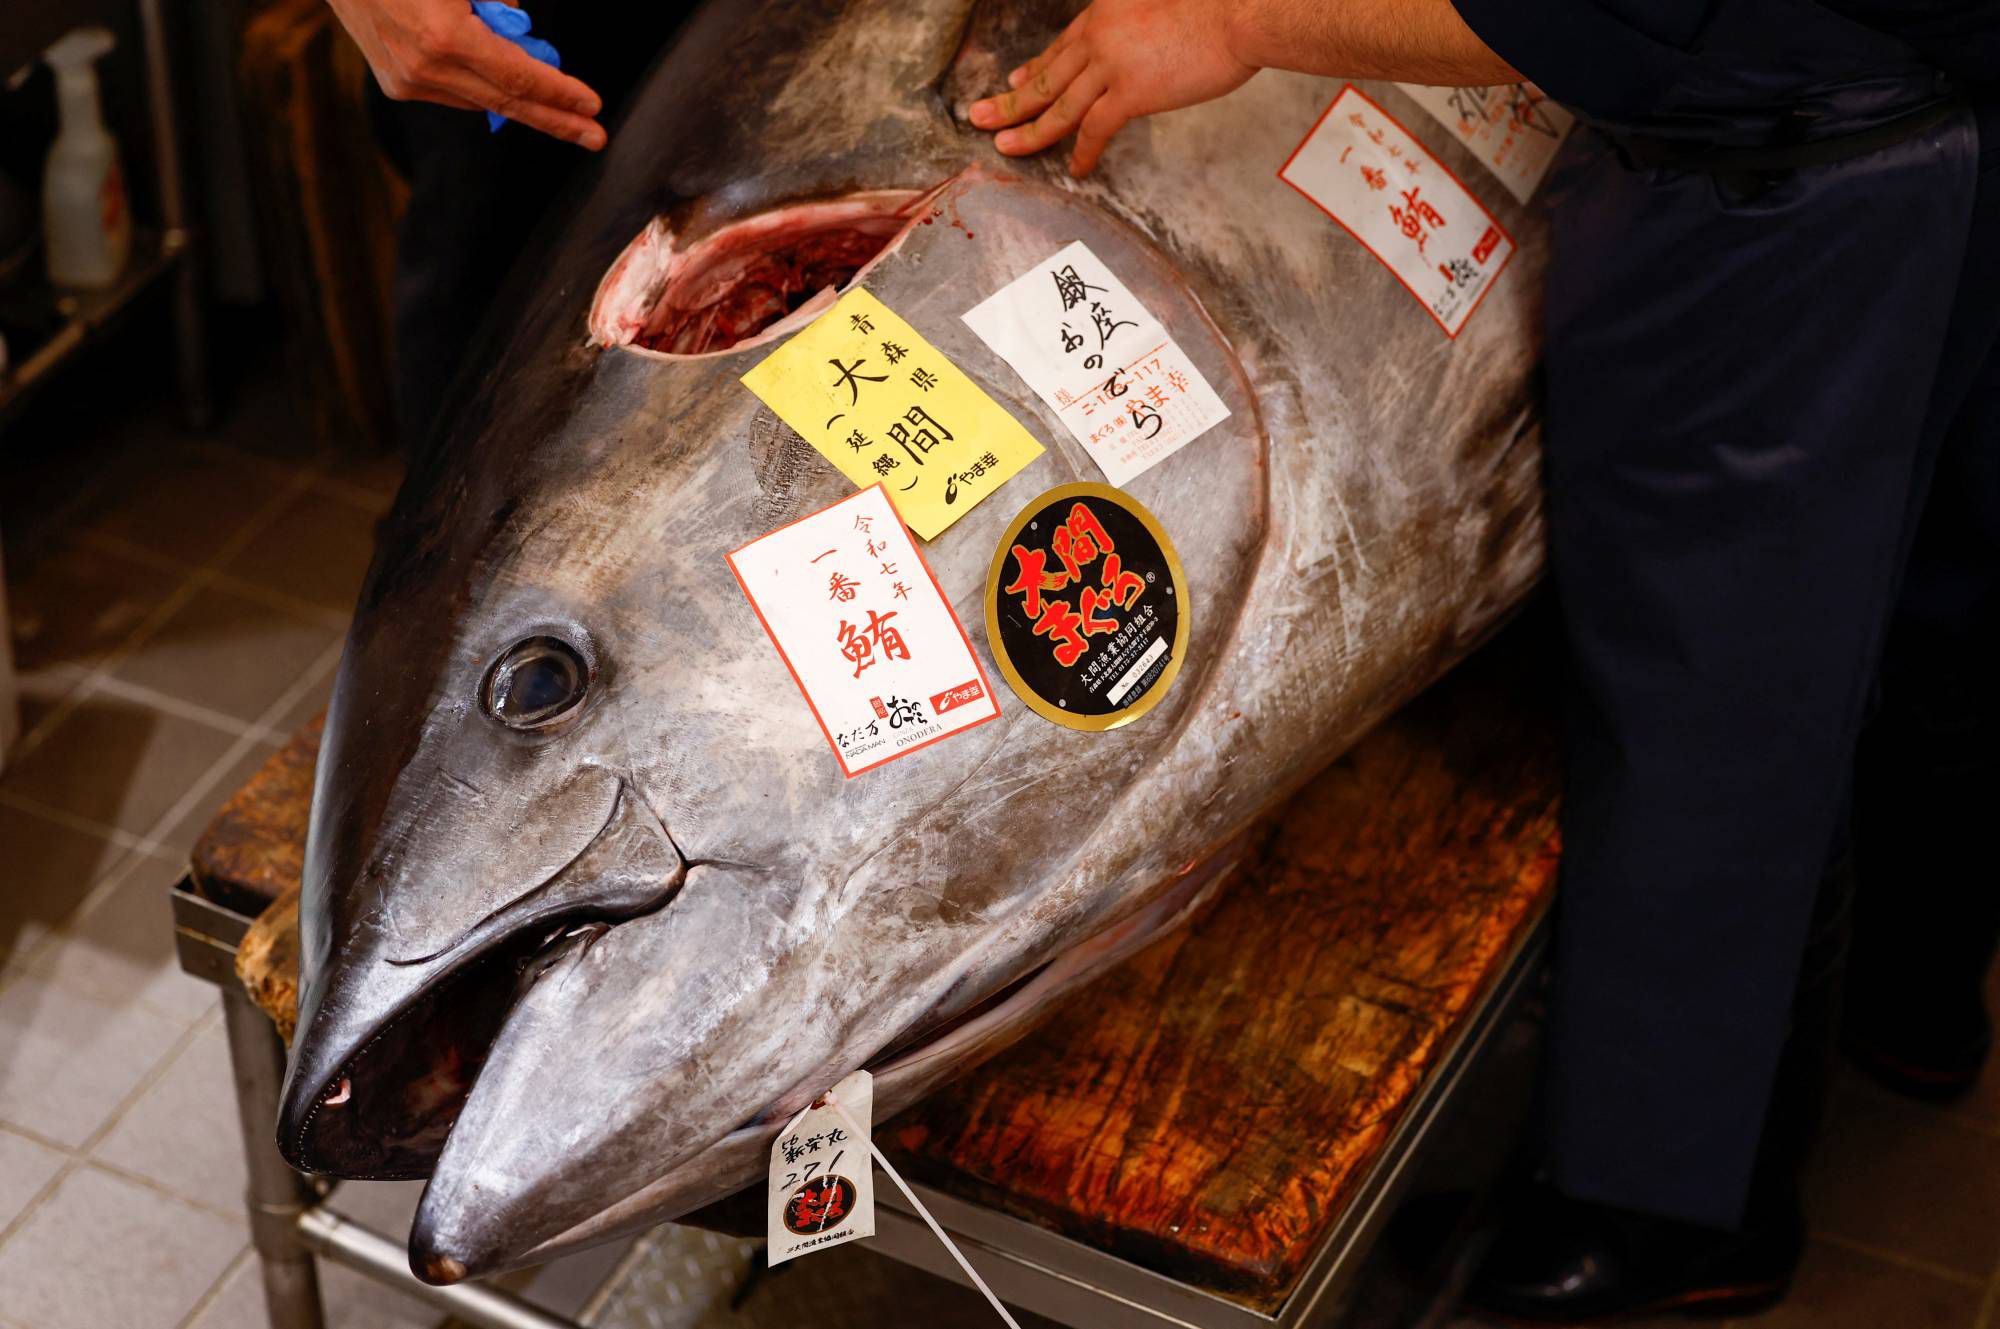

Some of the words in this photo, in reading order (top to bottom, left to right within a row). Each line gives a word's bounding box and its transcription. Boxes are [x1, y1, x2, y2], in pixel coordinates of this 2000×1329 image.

[850, 313, 938, 392] 青森県
[1061, 322, 1162, 440] おのでら
[828, 358, 954, 466] 大間
[959, 451, 999, 486] やま幸
[854, 514, 912, 600] 令和七年
[1005, 502, 1115, 619] 大間
[1033, 553, 1145, 667] まぐろ
[1080, 604, 1155, 687] 大間漁業協同組合
[836, 720, 879, 748] なだ万
[952, 685, 982, 702] やま幸
[896, 724, 943, 747] ONODERA
[780, 1150, 844, 1191] 271
